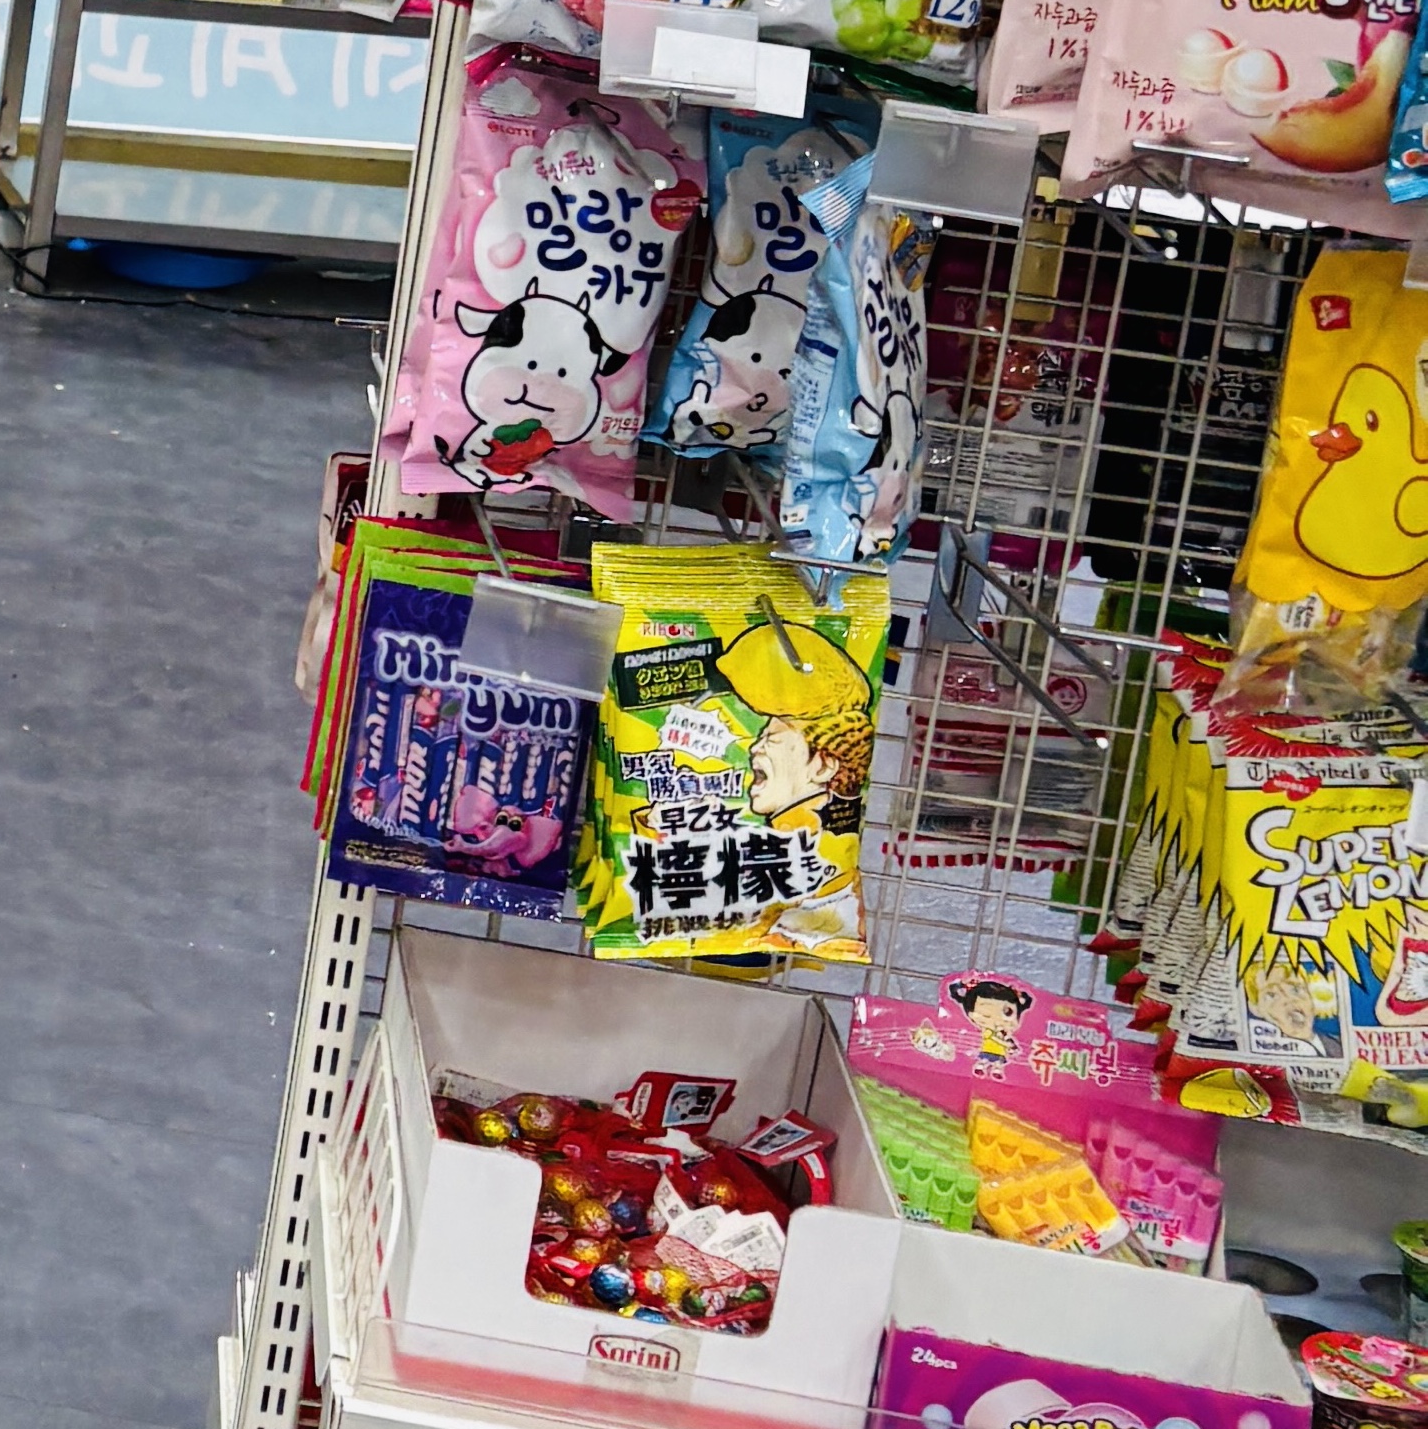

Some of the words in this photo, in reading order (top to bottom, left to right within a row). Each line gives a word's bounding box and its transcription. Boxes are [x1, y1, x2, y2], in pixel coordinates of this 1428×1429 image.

[1033, 0, 1100, 34] 자두과즙
[1110, 68, 1177, 103] 자두과즙
[526, 186, 644, 272] 말랑
[588, 241, 666, 307] 카우
[463, 689, 579, 735] yum
[659, 804, 743, 835] 早乙女
[628, 832, 803, 912] 檸檬
[1354, 1027, 1409, 1052] NOBEL
[1030, 1038, 1119, 1088] 쥬씨봉
[593, 1335, 673, 1373] Sorini
